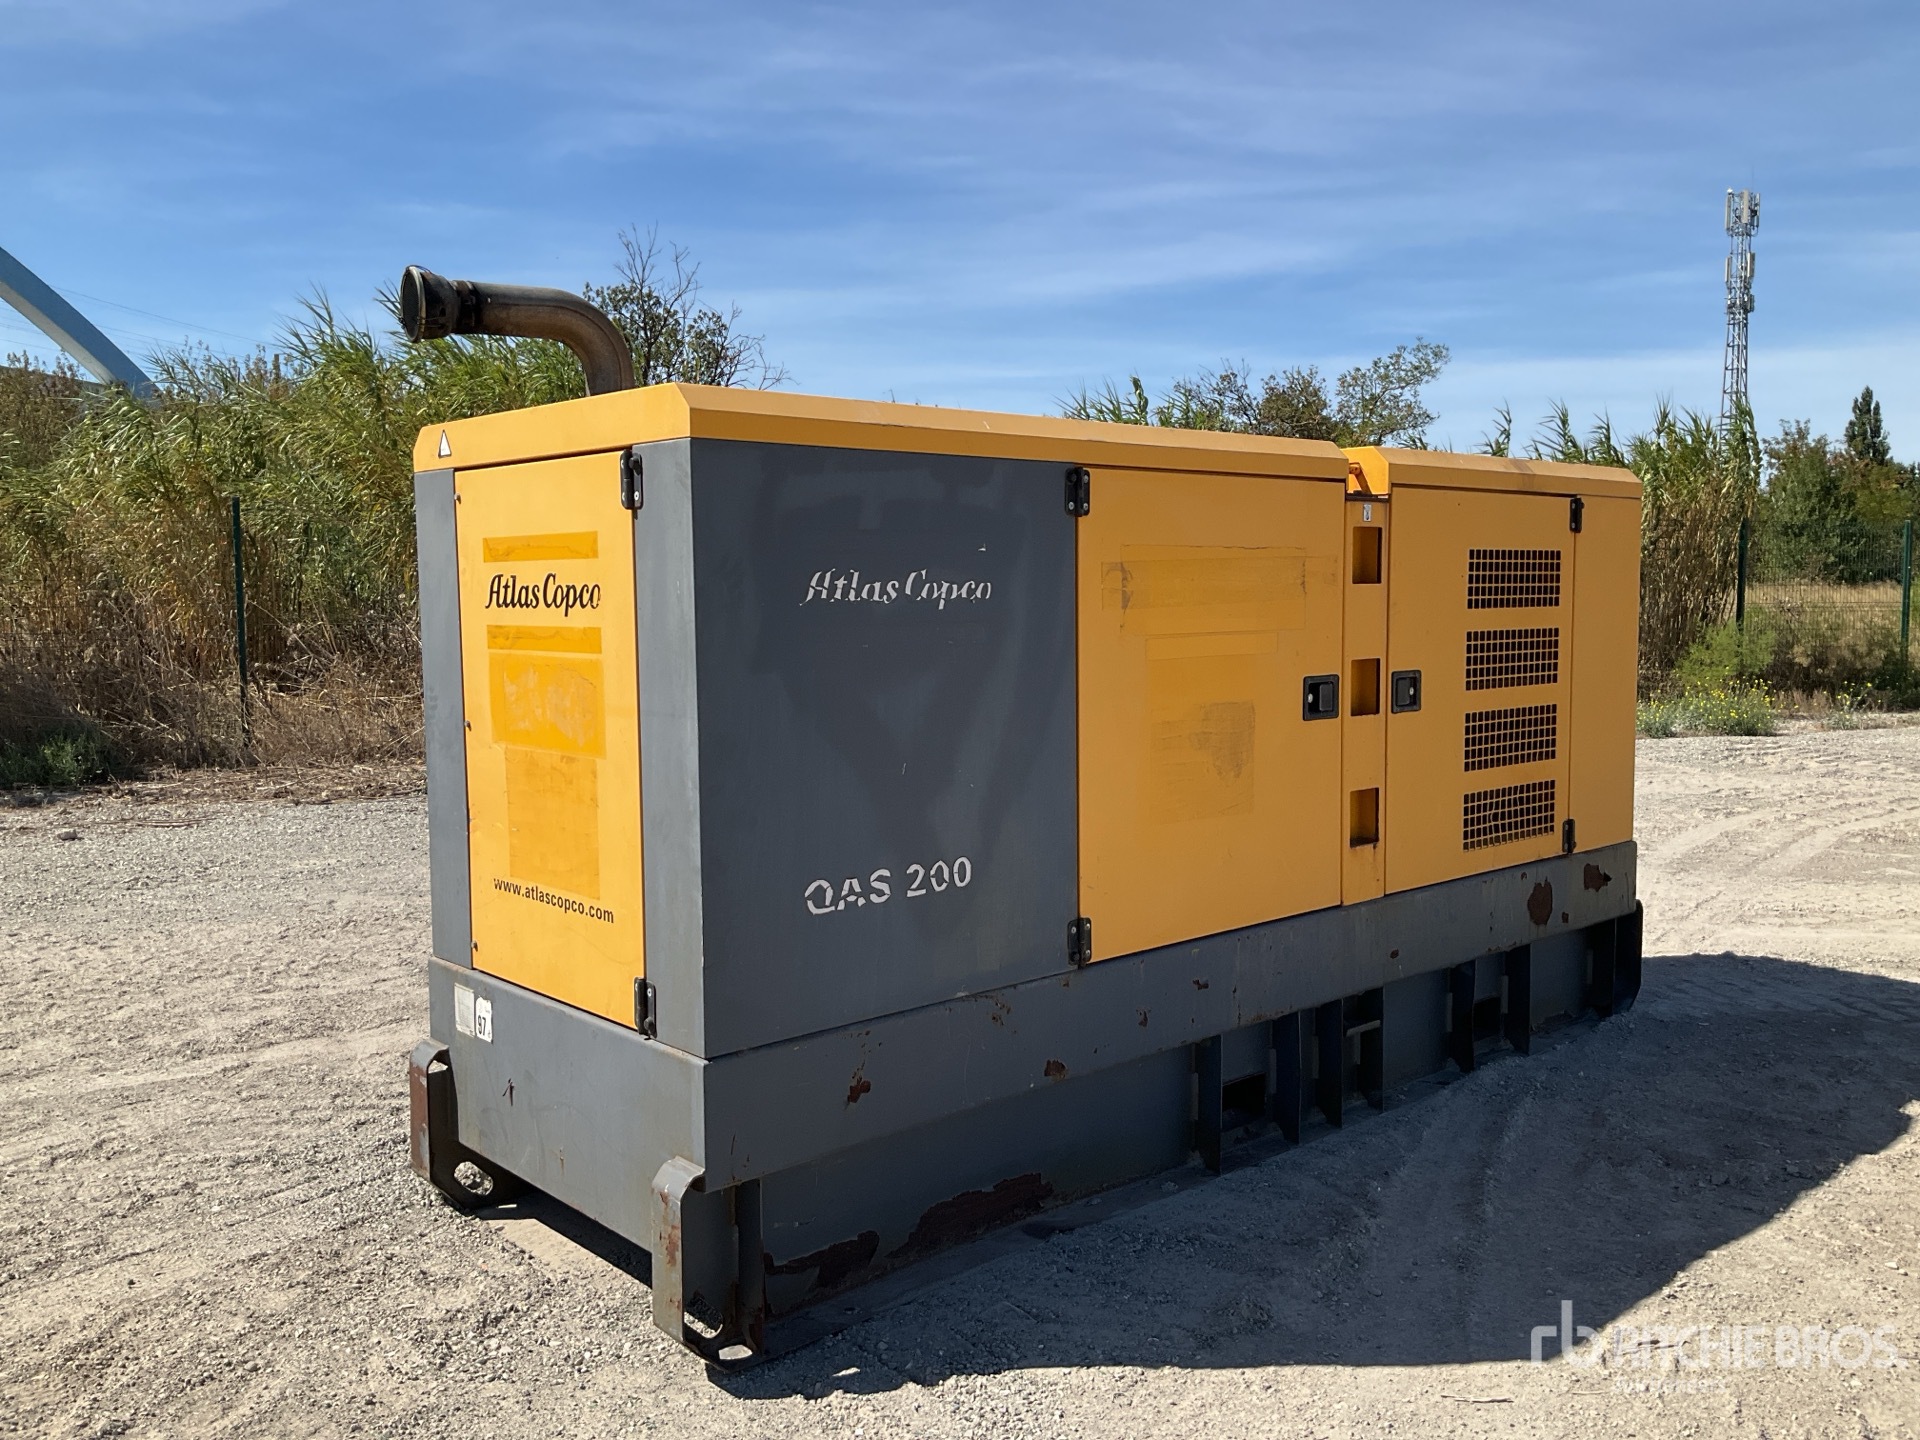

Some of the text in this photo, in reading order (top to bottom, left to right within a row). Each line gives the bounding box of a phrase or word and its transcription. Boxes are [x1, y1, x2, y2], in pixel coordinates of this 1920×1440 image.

[485, 572, 601, 617] Atlas Copco
[799, 568, 992, 610] Atlas Copco
[493, 877, 614, 924] www.atlascopco.com
[804, 856, 972, 915] QAS 200
